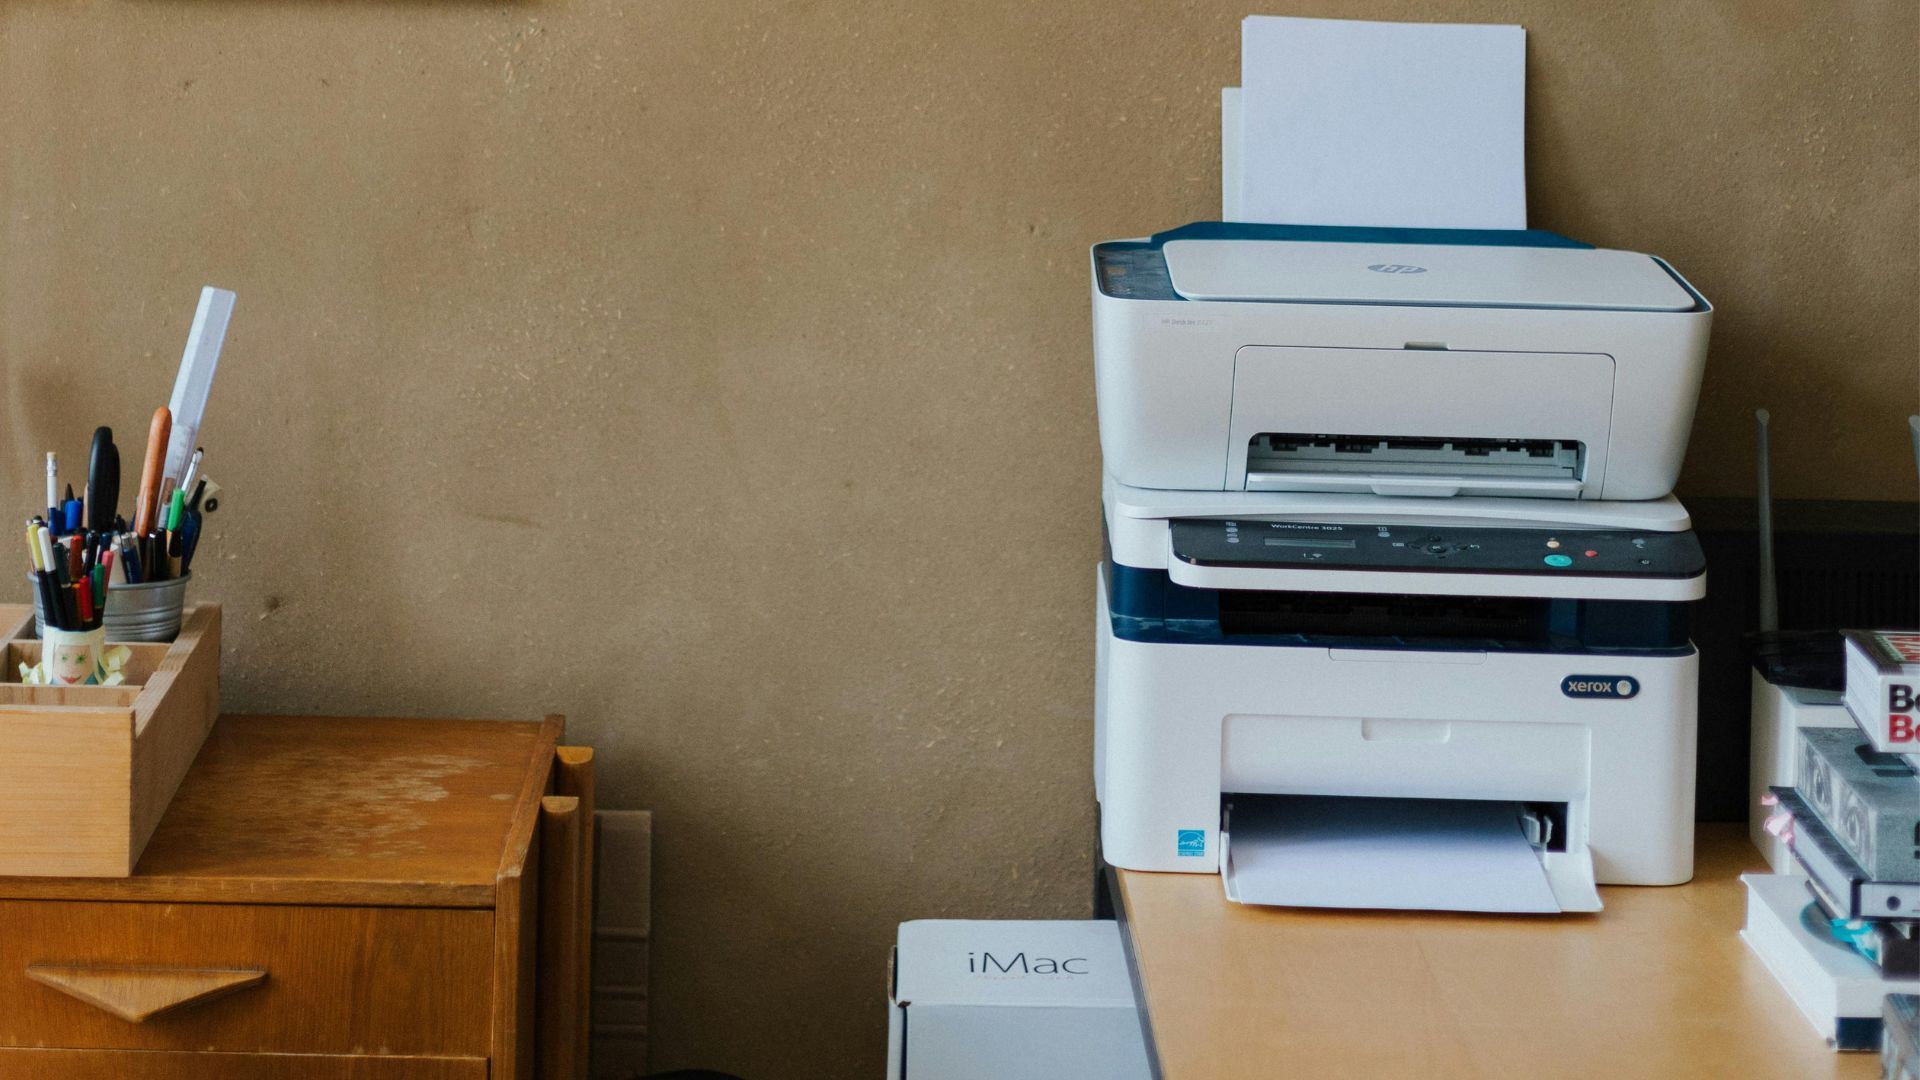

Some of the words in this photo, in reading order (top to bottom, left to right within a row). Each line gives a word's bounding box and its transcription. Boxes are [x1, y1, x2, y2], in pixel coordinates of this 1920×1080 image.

[1568, 681, 1612, 693] xerox
[1888, 684, 1920, 713] B
[1888, 714, 1920, 743] B
[968, 952, 1089, 974] iMac
